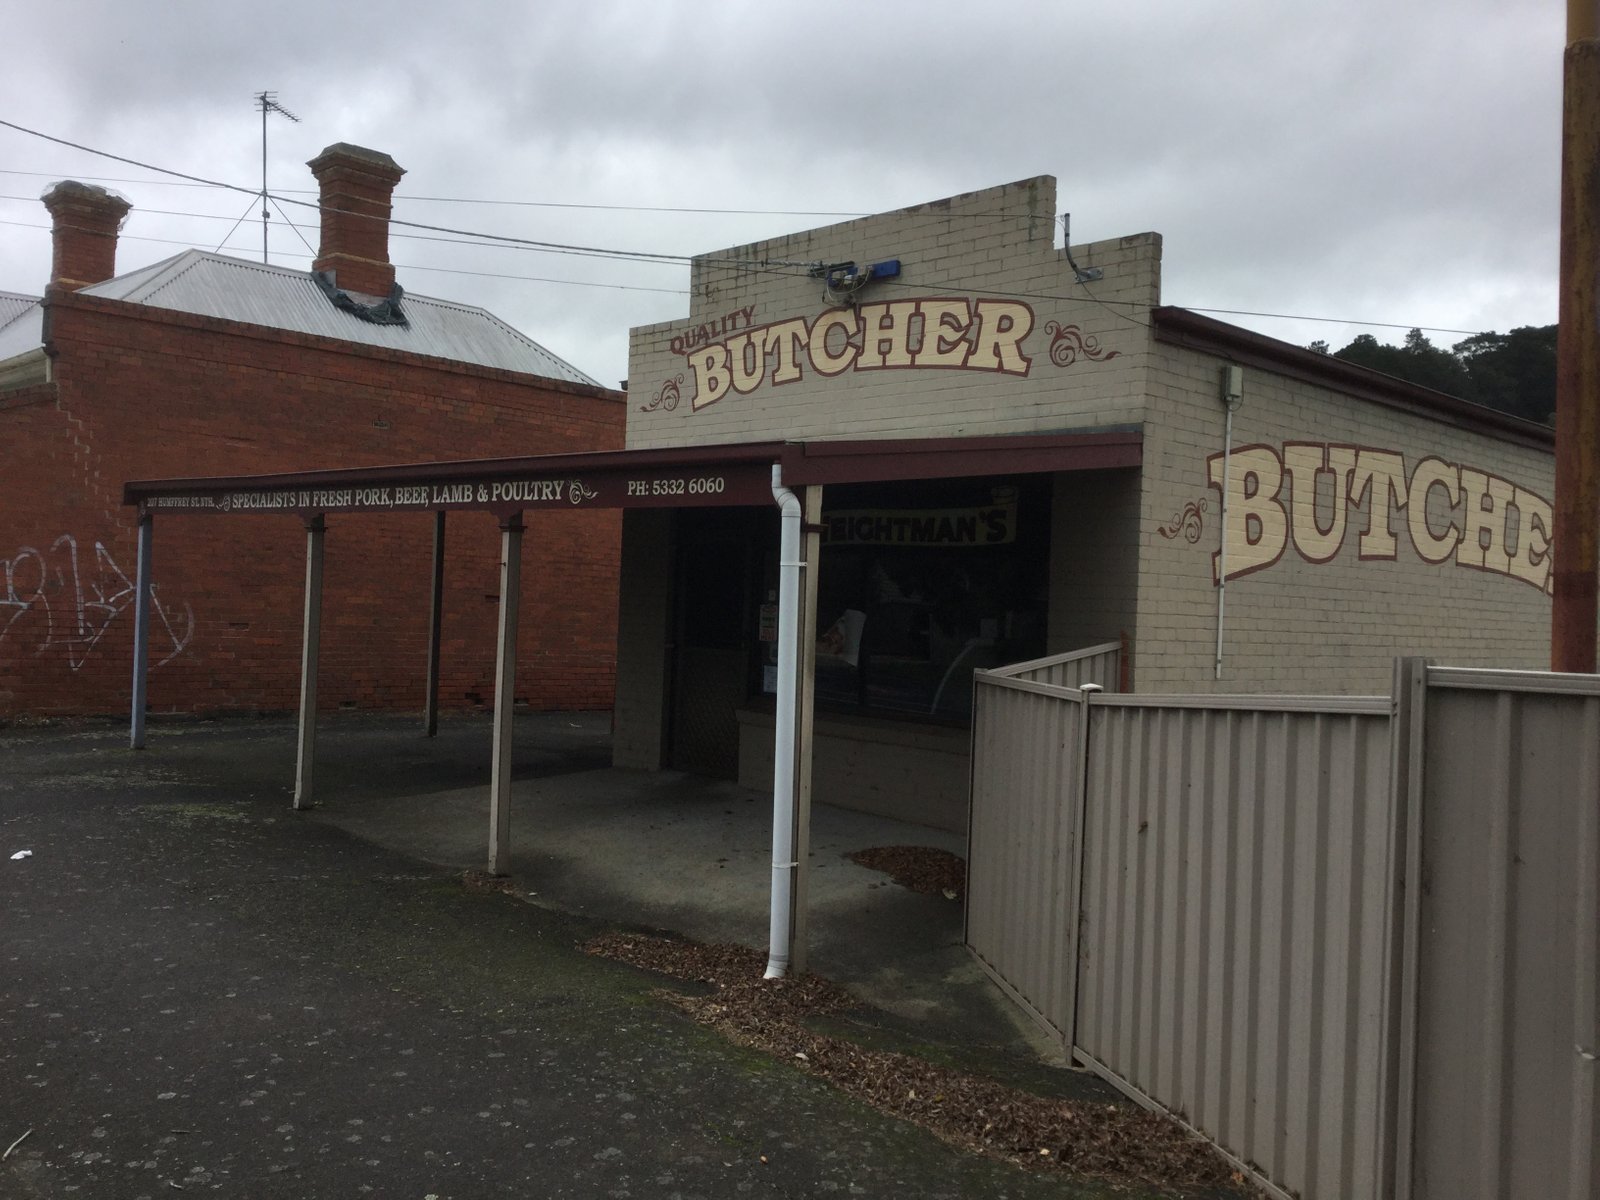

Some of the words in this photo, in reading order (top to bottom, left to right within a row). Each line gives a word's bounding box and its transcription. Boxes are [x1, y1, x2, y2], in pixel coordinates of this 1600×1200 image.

[669, 305, 756, 356] QUALITY
[687, 296, 1035, 412] BUTCHER
[232, 491, 296, 508] SPECIALISTS
[298, 491, 310, 507] IN
[313, 489, 352, 507] FRESH
[432, 484, 473, 503] LAMB
[477, 482, 489, 502] &
[491, 480, 565, 501] POULTRY
[628, 480, 649, 495] PH:
[652, 479, 685, 495] 5332
[688, 477, 725, 494] 6060
[1206, 441, 1555, 597] BUTCHE
